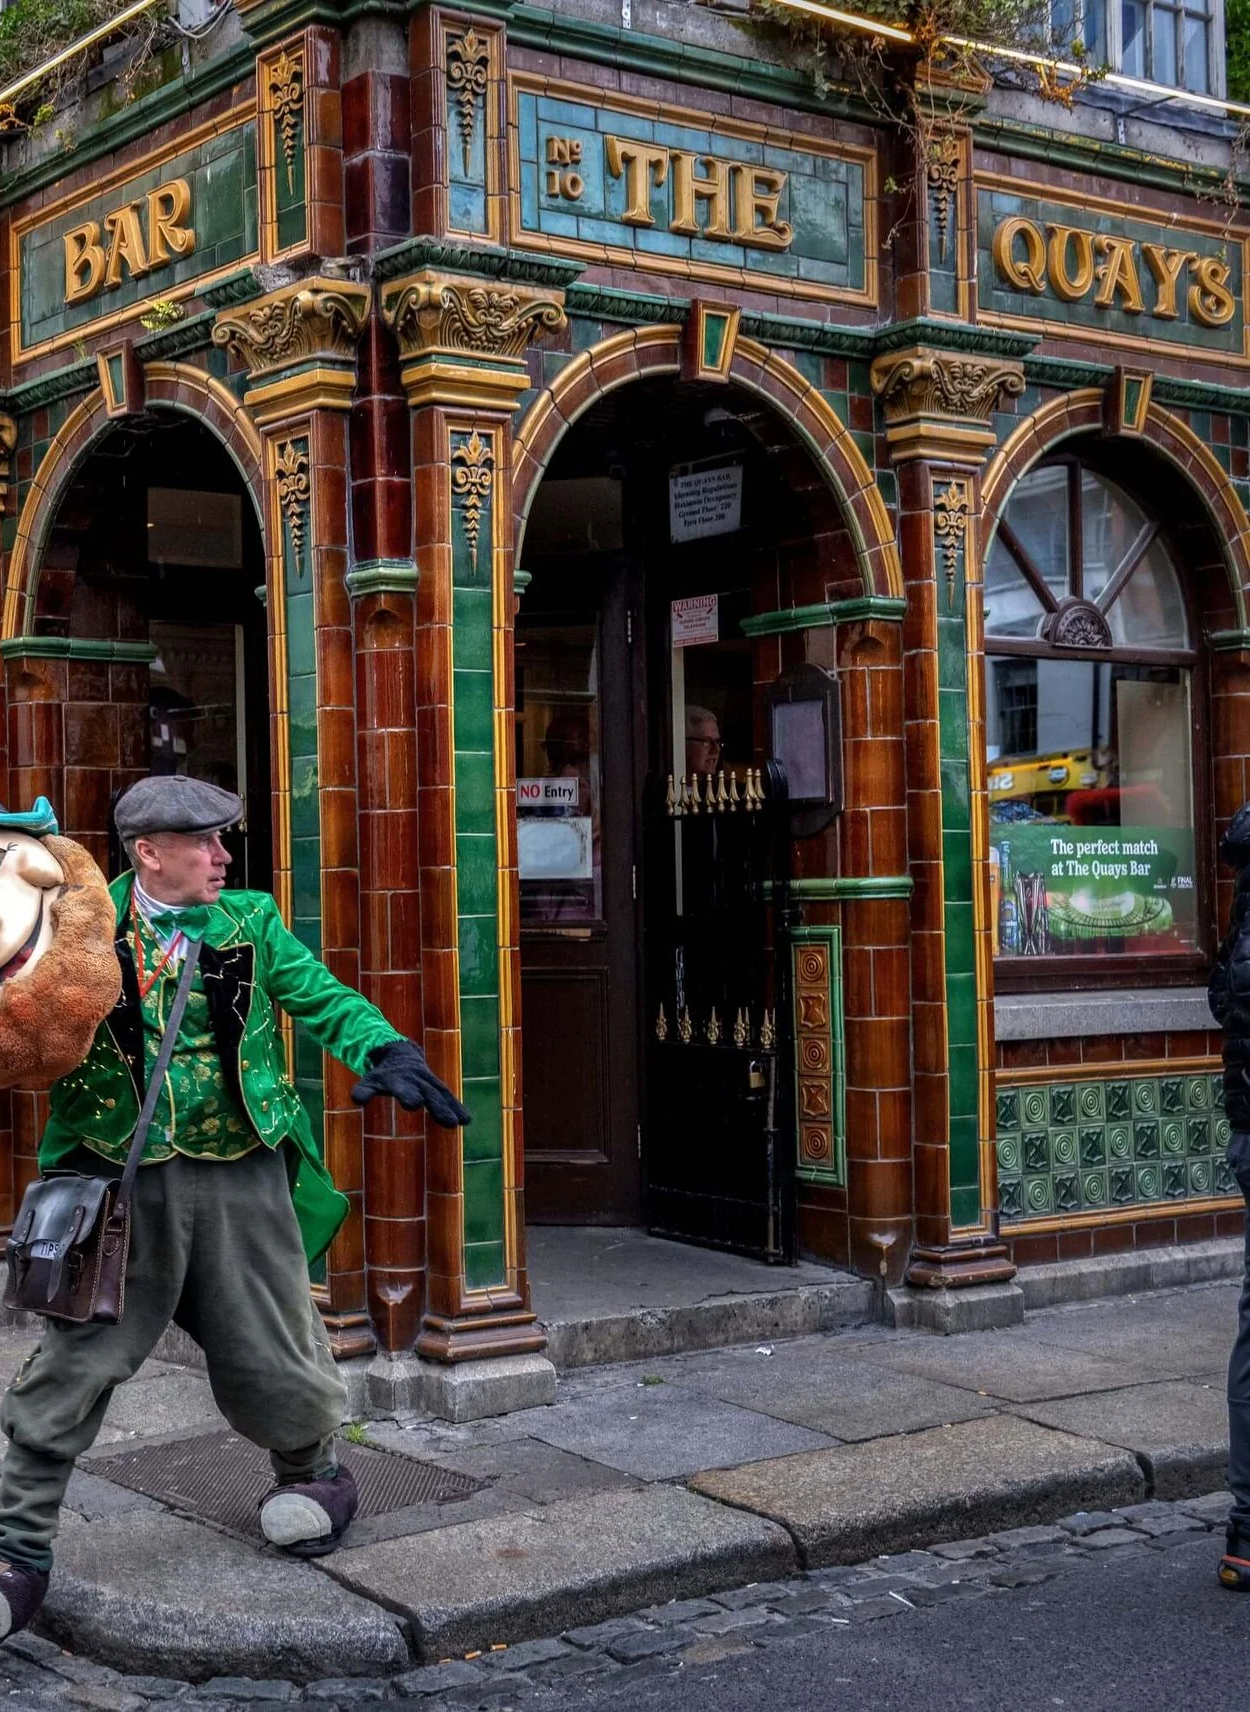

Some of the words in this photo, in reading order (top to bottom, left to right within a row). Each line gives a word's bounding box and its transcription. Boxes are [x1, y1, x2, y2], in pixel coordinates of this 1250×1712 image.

[546, 170, 583, 200] 10
[604, 134, 792, 251] THE
[993, 216, 1235, 327] QUAYS
[63, 178, 196, 305] BAR
[672, 595, 717, 613] WARNING
[520, 784, 541, 799] NO
[544, 784, 574, 802] Entry
[1050, 838, 1074, 856] The
[1076, 839, 1120, 859] perfect
[1122, 839, 1159, 856] match
[1051, 860, 1064, 877] at
[1066, 860, 1090, 877] The
[1092, 860, 1128, 880] Quays
[1130, 860, 1151, 877] Bar
[1177, 876, 1192, 884] FINAL
